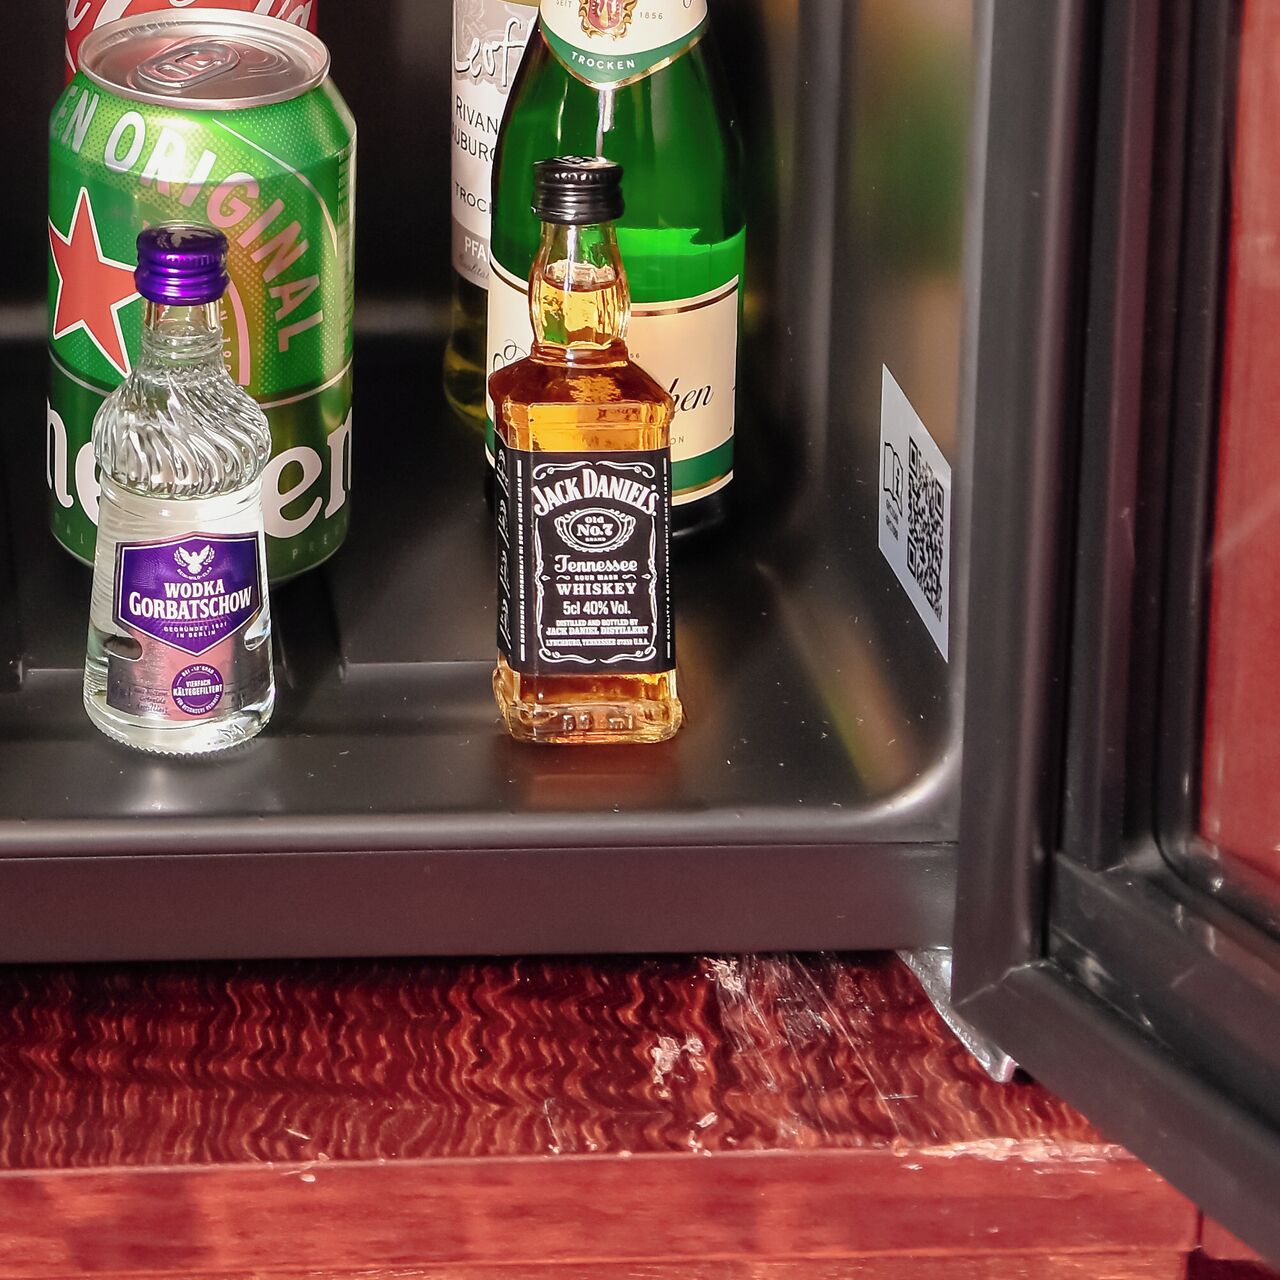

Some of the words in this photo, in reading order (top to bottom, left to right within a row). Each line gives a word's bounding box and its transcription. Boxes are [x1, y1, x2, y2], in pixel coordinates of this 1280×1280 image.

[639, 11, 664, 20] 1856
[571, 51, 636, 70] TROCKEN
[455, 183, 492, 214] TROC
[104, 110, 324, 353] ORIGINAL
[464, 236, 490, 263] PFA
[531, 477, 583, 516] JACK
[584, 516, 605, 524] Old
[554, 554, 638, 573] Tennessee
[164, 579, 225, 598] WODKA
[556, 582, 638, 595] WHISKEY
[129, 586, 252, 620] GORBATSCHOW
[562, 600, 580, 615] 5cl
[582, 600, 609, 615] 40%
[609, 600, 632, 615] Vol.
[545, 627, 568, 635] JACK
[568, 626, 599, 635] DANIEL
[600, 625, 649, 635] DISTILLERY
[555, 619, 587, 627] DISTILLED
[601, 619, 629, 627] BOTTLED
[629, 618, 639, 626] BY
[188, 630, 216, 638] BERLIN
[172, 684, 223, 697] KÄLTEGEFILTERT
